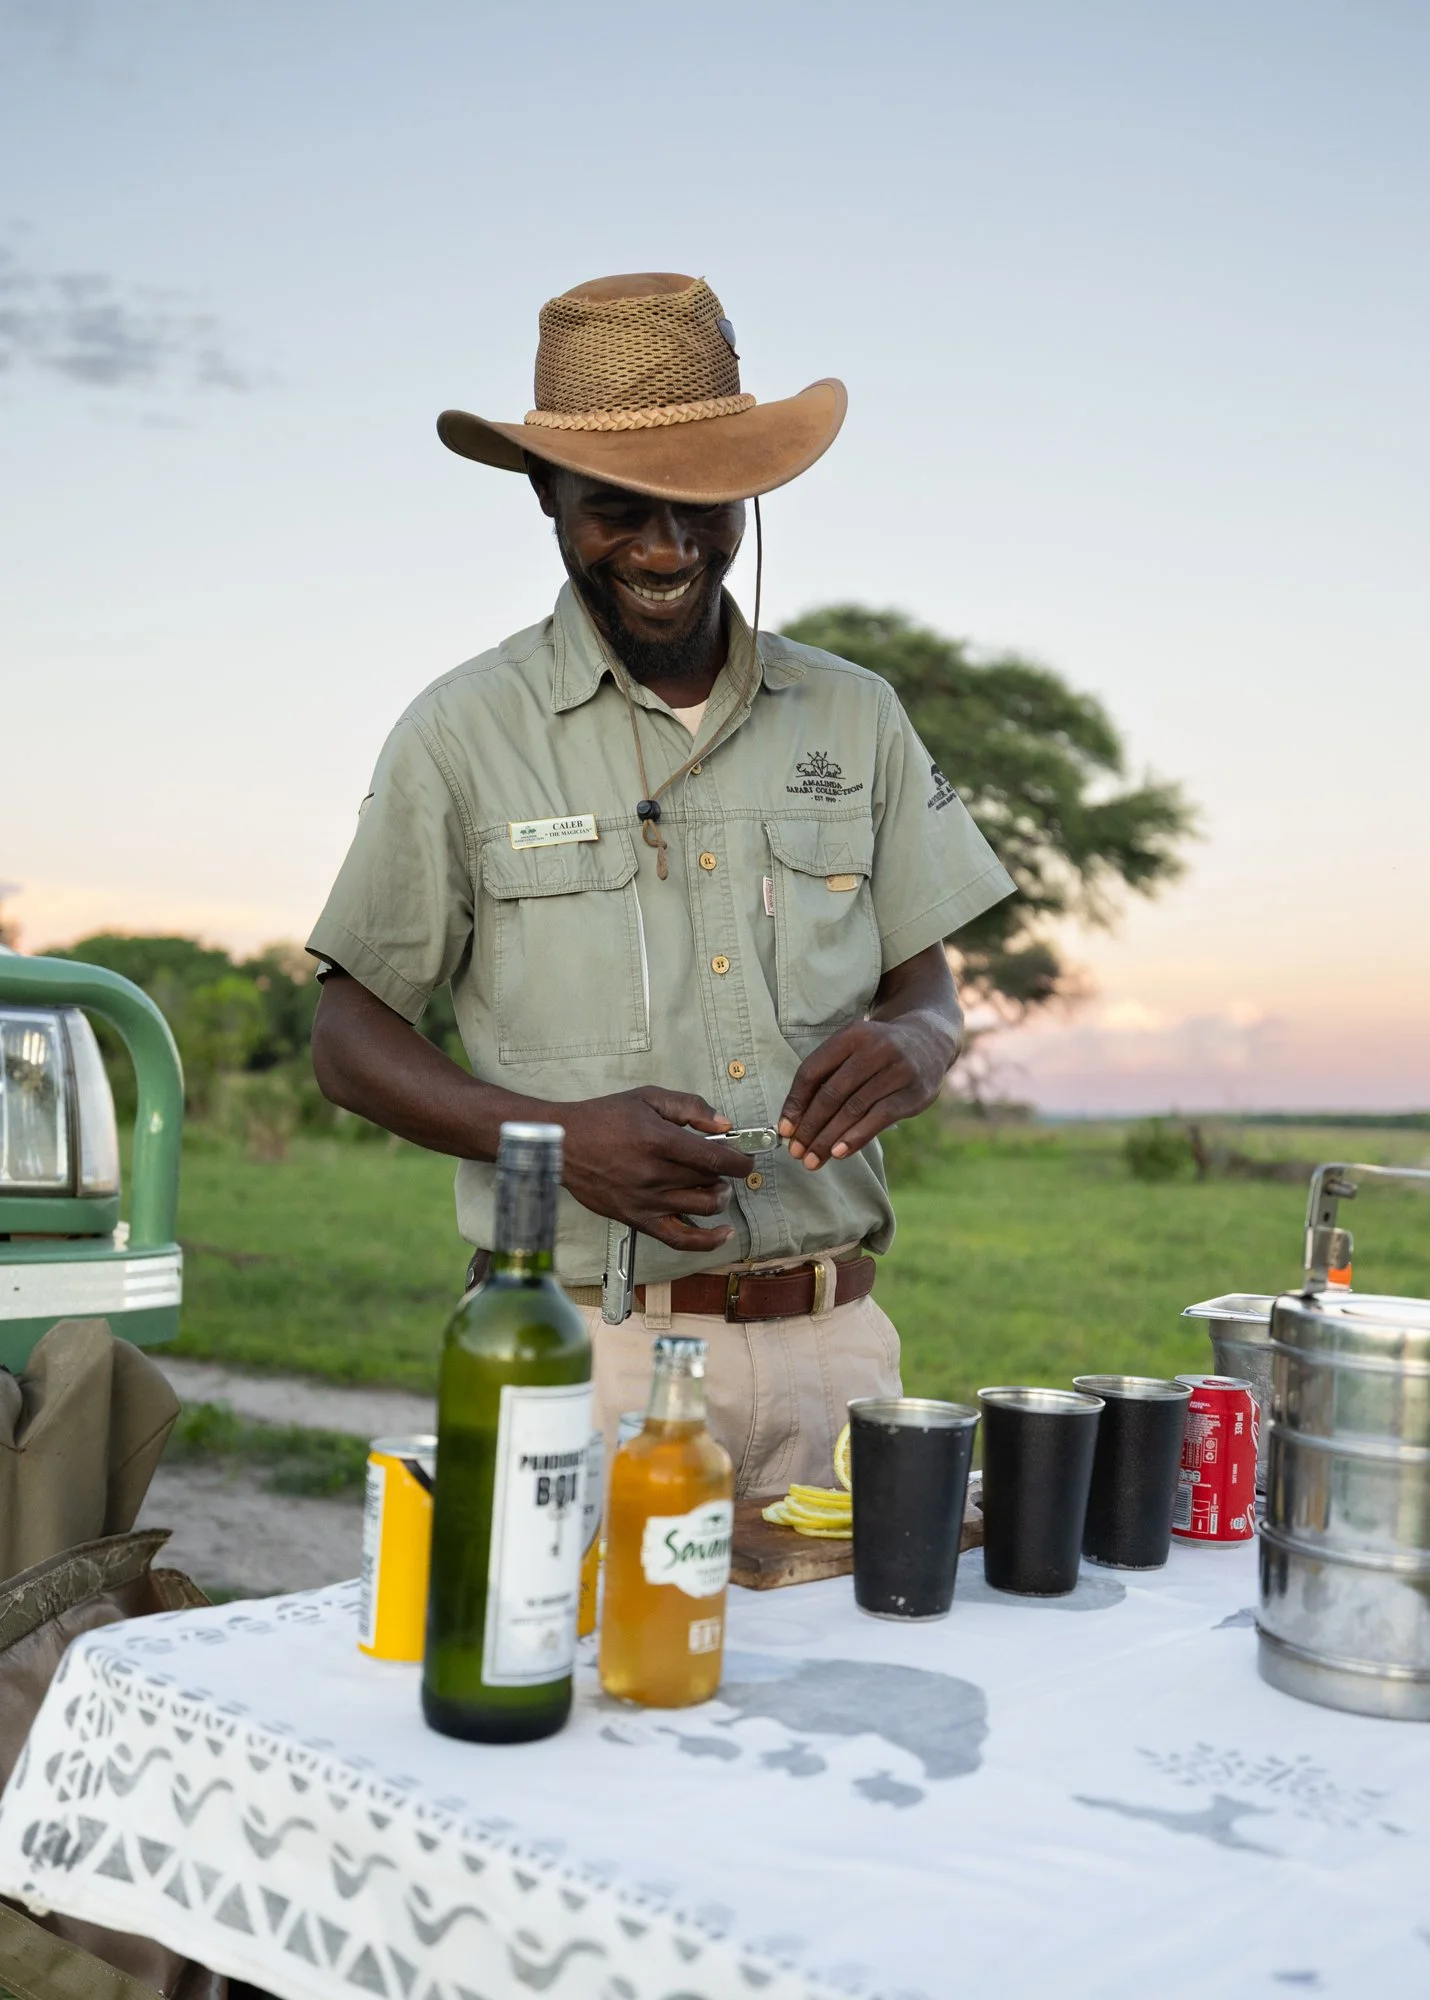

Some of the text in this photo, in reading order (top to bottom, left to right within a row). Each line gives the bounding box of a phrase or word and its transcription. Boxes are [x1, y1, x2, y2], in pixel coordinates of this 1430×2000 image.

[802, 780, 843, 789] AMALINDA
[815, 783, 864, 796] COLLECTION
[552, 820, 584, 831] CALEB
[1234, 1411, 1244, 1436] 330 ml
